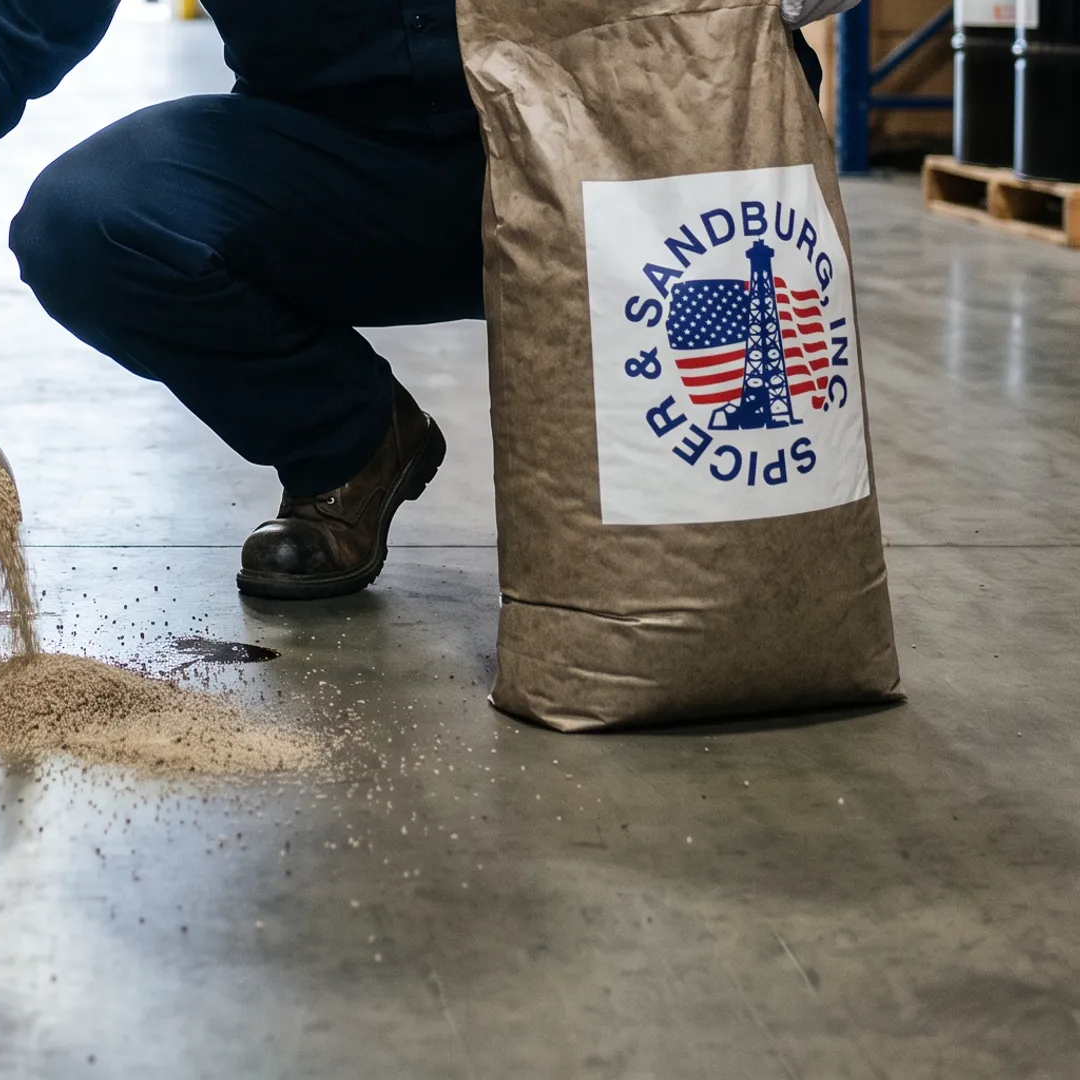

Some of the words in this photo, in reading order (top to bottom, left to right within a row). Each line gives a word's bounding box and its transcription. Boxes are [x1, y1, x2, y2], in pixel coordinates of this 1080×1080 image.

[624, 200, 833, 328] SANDBURG,
[624, 346, 662, 380] &
[823, 317, 849, 412] INC.
[645, 394, 817, 486] SPICER
